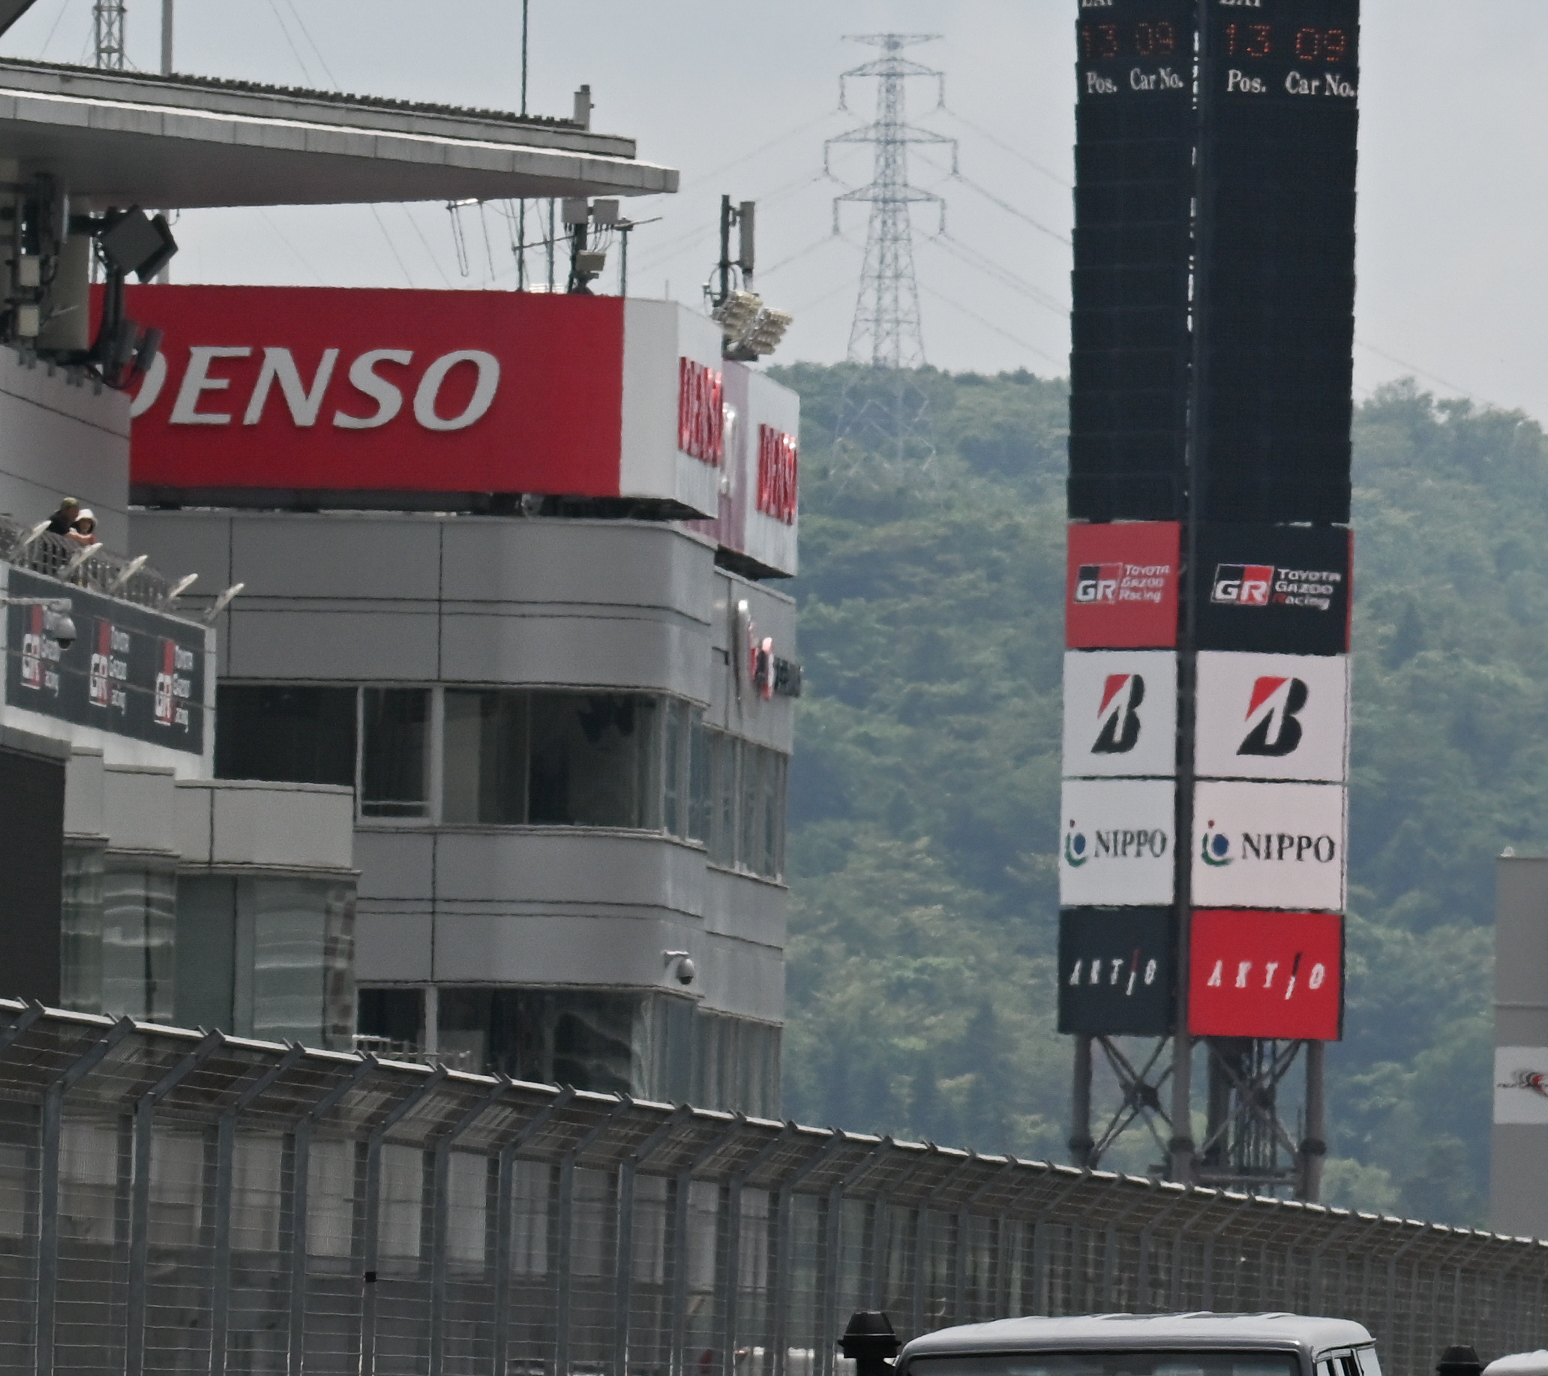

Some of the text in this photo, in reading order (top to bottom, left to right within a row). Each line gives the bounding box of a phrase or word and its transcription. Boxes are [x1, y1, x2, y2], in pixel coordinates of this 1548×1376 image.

[1226, 23, 1270, 57] 13
[1086, 67, 1183, 94] Pos. Car No.
[1227, 70, 1357, 97] Pos. Car No.
[1076, 580, 1117, 602] GR
[1215, 580, 1267, 602] GR
[1094, 829, 1167, 858] NIPPO
[1241, 833, 1336, 863] NIPPO
